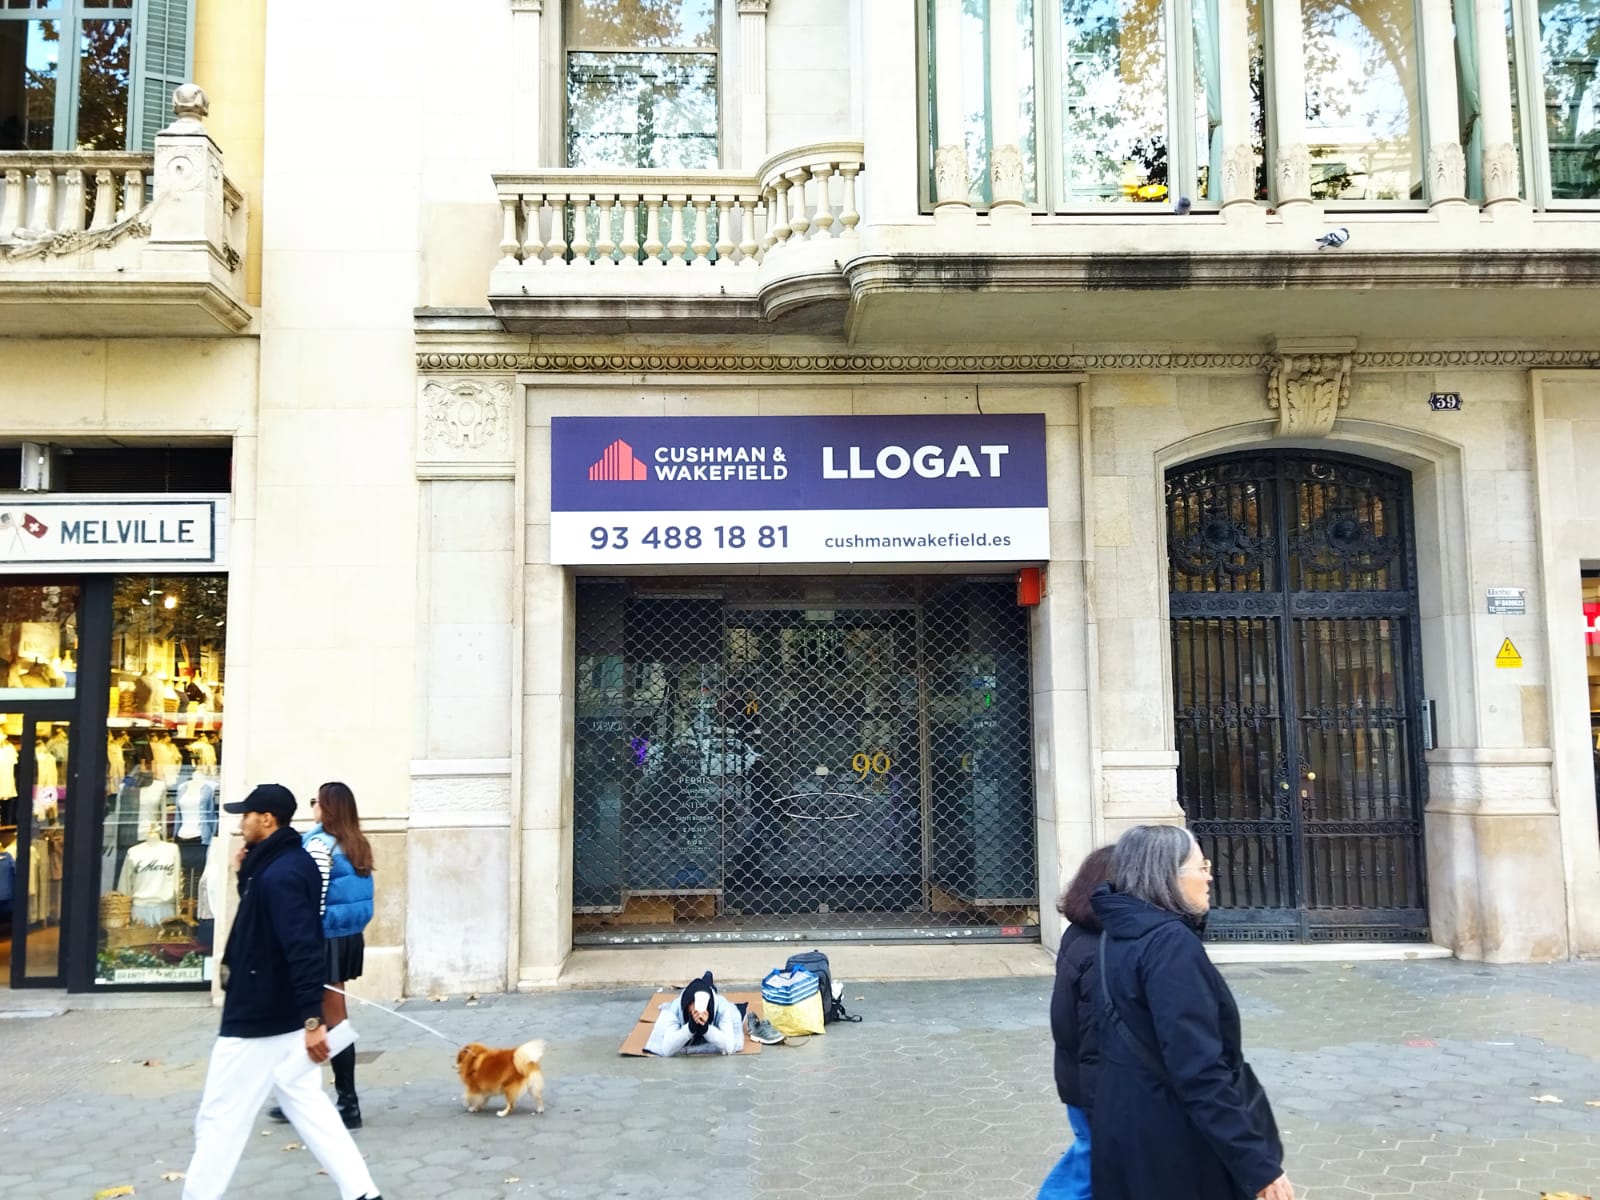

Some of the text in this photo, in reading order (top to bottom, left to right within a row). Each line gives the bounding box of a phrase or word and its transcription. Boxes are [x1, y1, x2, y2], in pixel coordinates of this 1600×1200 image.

[1436, 394, 1456, 409] 39
[654, 446, 787, 463] CUSHMAN &
[822, 445, 1009, 479] LLOGAT
[654, 465, 788, 481] WAKEFIELD
[60, 520, 194, 544] MELVILLE
[590, 525, 788, 549] 93 488 18 81
[825, 533, 1011, 548] cushmanwakefield.es
